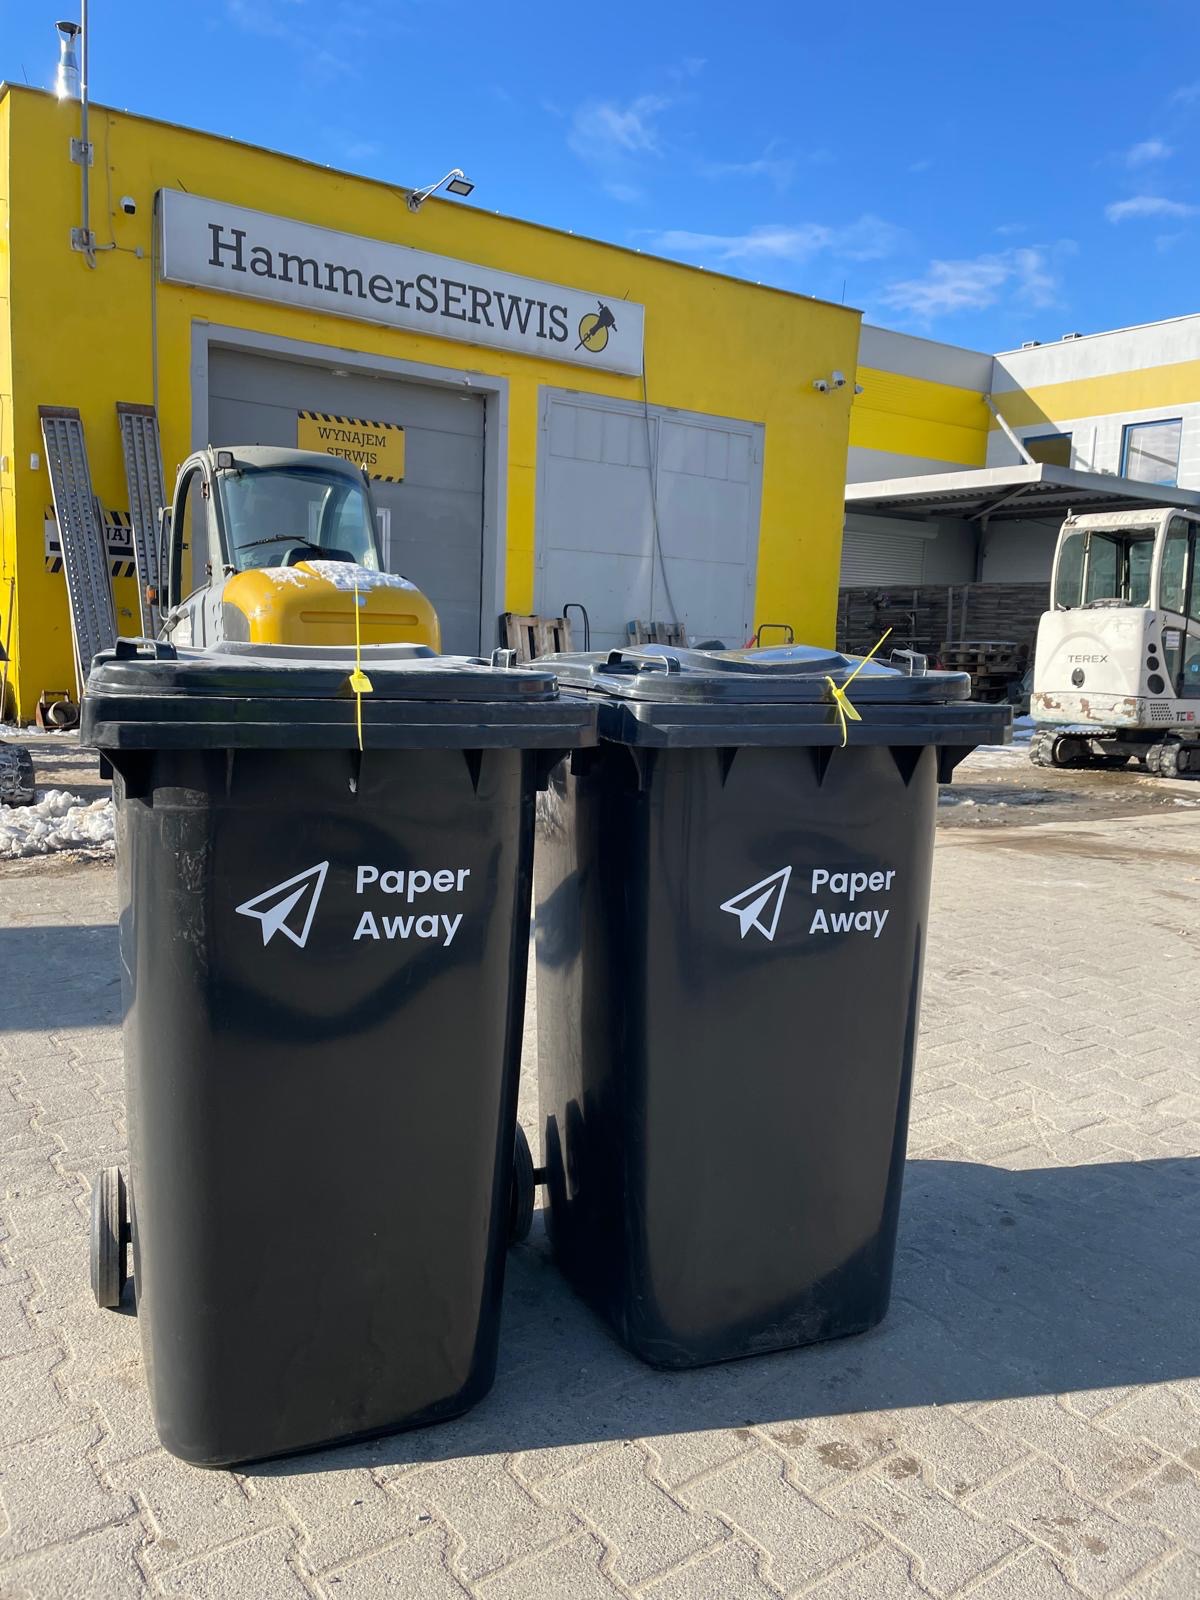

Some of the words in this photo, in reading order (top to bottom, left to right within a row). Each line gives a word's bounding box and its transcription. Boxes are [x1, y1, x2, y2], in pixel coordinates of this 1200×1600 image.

[208, 223, 569, 343] HammerSERWIS
[318, 426, 387, 448] WYNAJEM
[1068, 654, 1108, 664] TEREX
[357, 866, 470, 902] Paper
[811, 869, 896, 902] Paper
[353, 911, 464, 947] Away
[808, 908, 890, 938] Away
